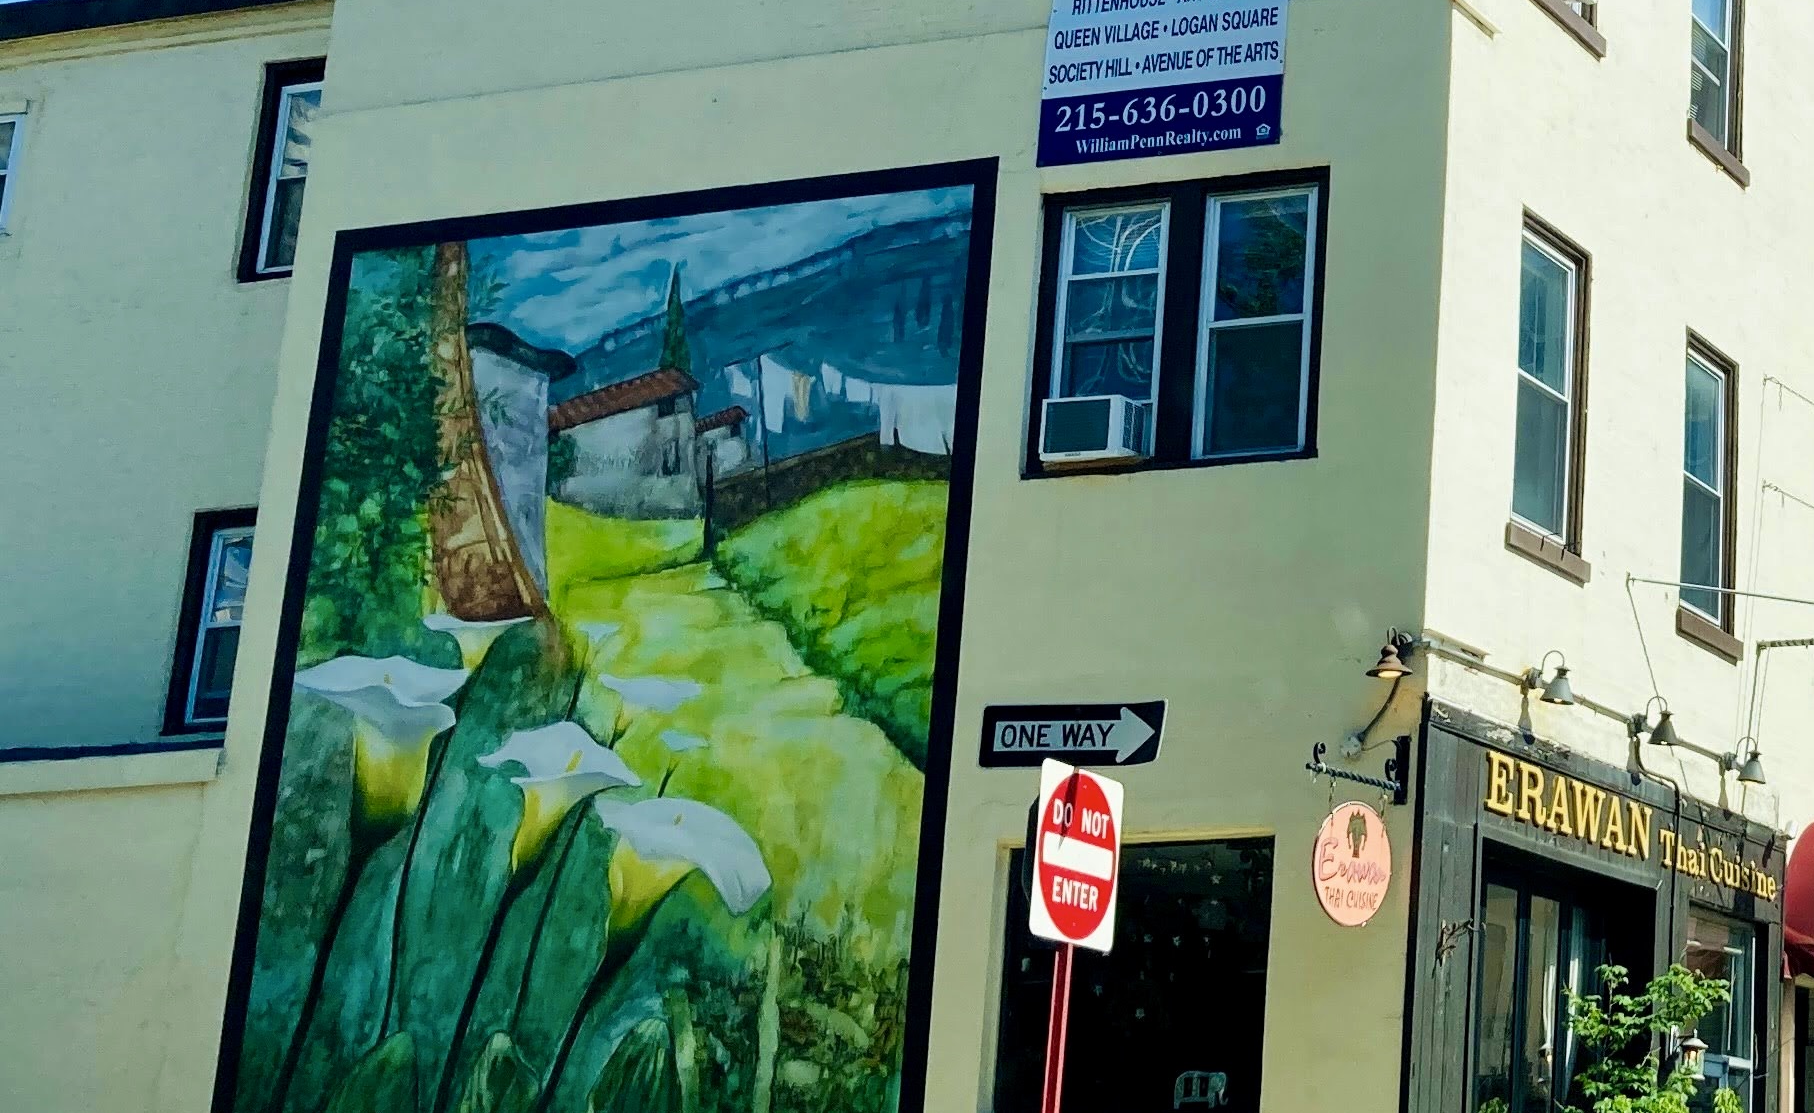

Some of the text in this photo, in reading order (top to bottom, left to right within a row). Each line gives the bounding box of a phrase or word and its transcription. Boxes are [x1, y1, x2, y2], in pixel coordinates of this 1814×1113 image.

[1054, 6, 1279, 50] QUEEN VILLAGE LOGAN SQUARE
[1048, 40, 1279, 85] SOCIETY HILL AVENUE OF THE ARTS
[1054, 85, 1266, 133] 215-636-0300
[1075, 125, 1242, 155] WilliamPennRealty.com
[1000, 722, 1115, 749] ONE WAY
[1053, 798, 1110, 839] DO NOT
[1483, 749, 1778, 902] ERAWAN Thai Cuisine
[1051, 875, 1099, 913] ENTER
[1325, 886, 1379, 911] THAI CUISINE
